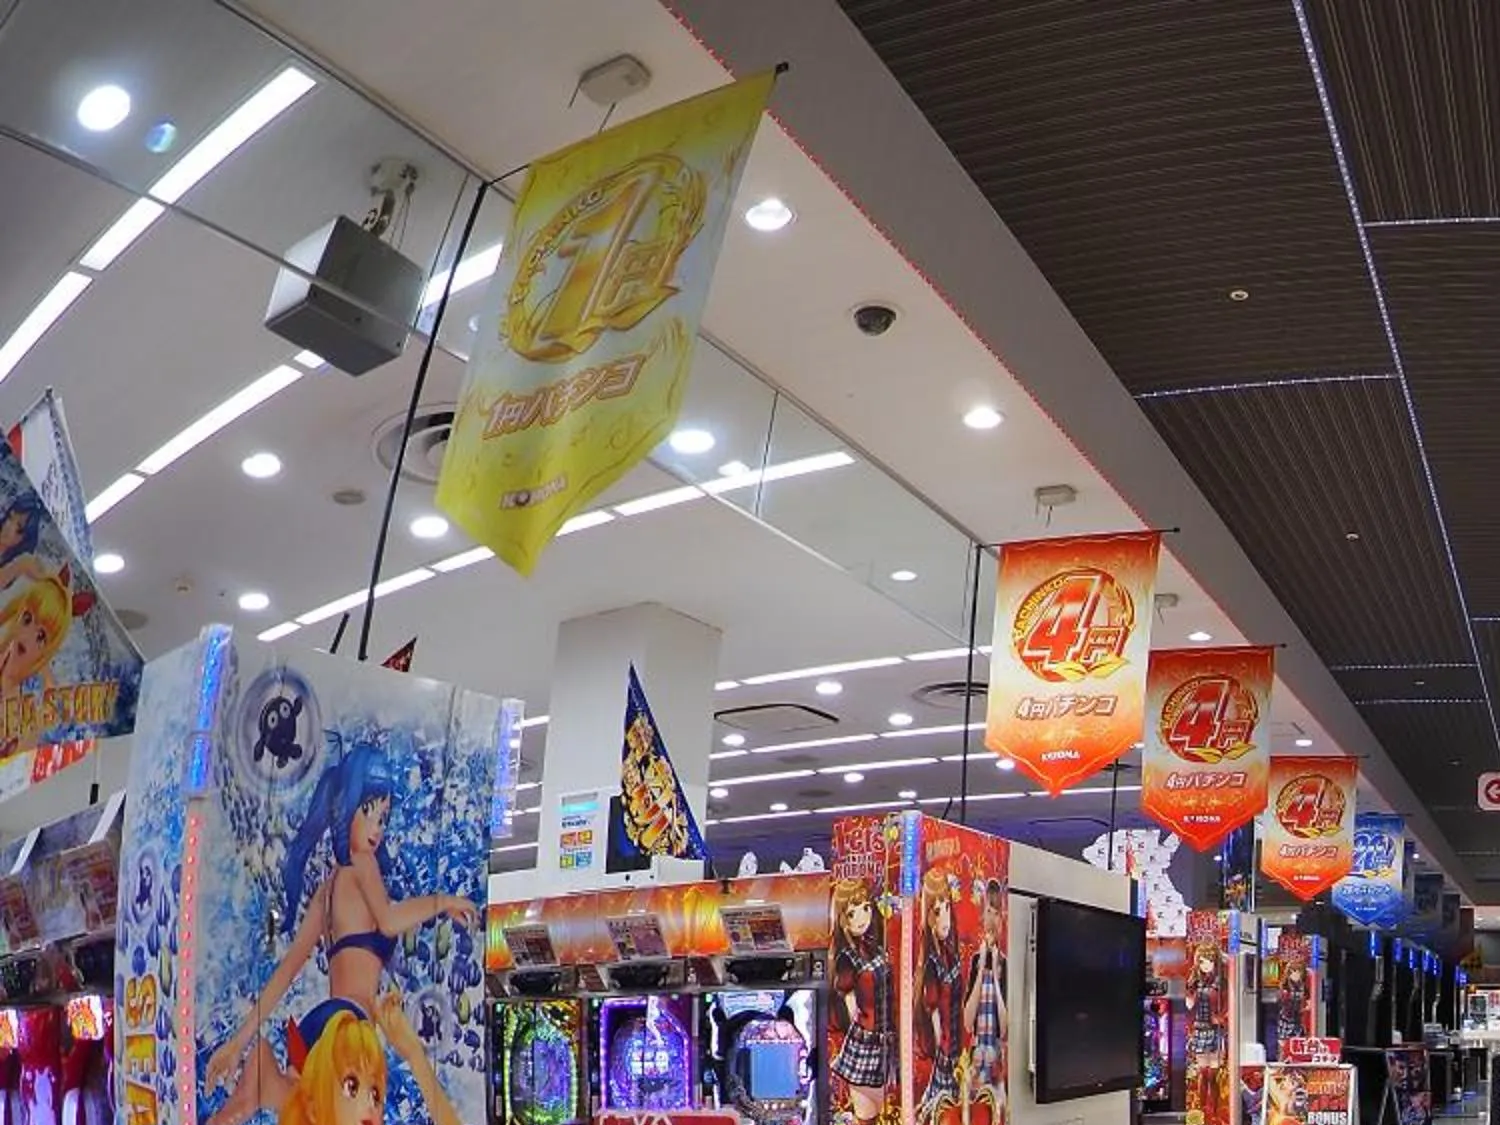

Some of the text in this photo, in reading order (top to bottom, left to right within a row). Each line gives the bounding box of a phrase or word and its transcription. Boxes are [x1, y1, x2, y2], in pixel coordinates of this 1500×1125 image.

[1016, 695, 1118, 721] 4円パチンコ
[1307, 1111, 1347, 1125] BONUS
